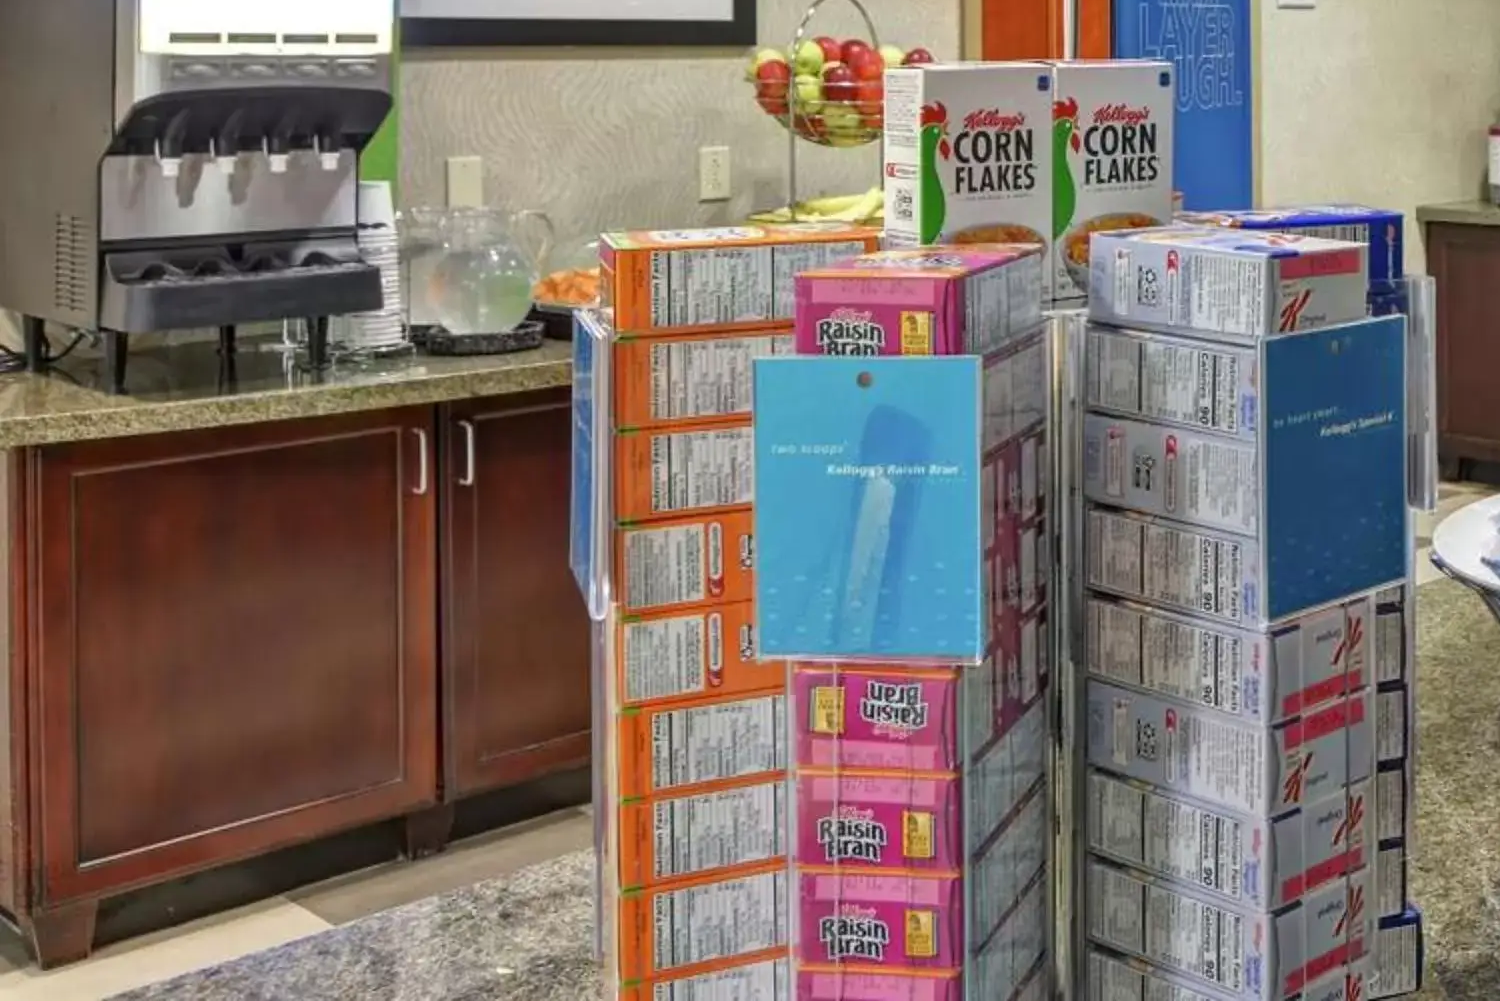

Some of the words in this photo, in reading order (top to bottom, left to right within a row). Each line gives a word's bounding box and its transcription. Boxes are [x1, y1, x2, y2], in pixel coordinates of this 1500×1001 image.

[1139, 2, 1235, 59] LAYER
[1176, 54, 1244, 113] UGH.
[964, 107, 1026, 131] Kellogg's
[1093, 103, 1150, 126] Kellogg's
[953, 128, 1034, 165] CORN
[1083, 122, 1157, 157] CORN
[955, 163, 1036, 194] FLAKES
[1085, 155, 1159, 186] FLAKES
[819, 320, 883, 343] Raisin
[1200, 406, 1210, 425] 90
[1203, 592, 1212, 611] 90
[869, 682, 919, 706] Bran
[1203, 685, 1213, 704] 90
[862, 701, 926, 727] Raisin
[819, 819, 885, 844] Raisin
[827, 839, 879, 861] Bran
[1203, 867, 1213, 886] 90
[820, 918, 888, 943] Raisin
[829, 938, 882, 959] Bran
[1205, 960, 1215, 980] 90
